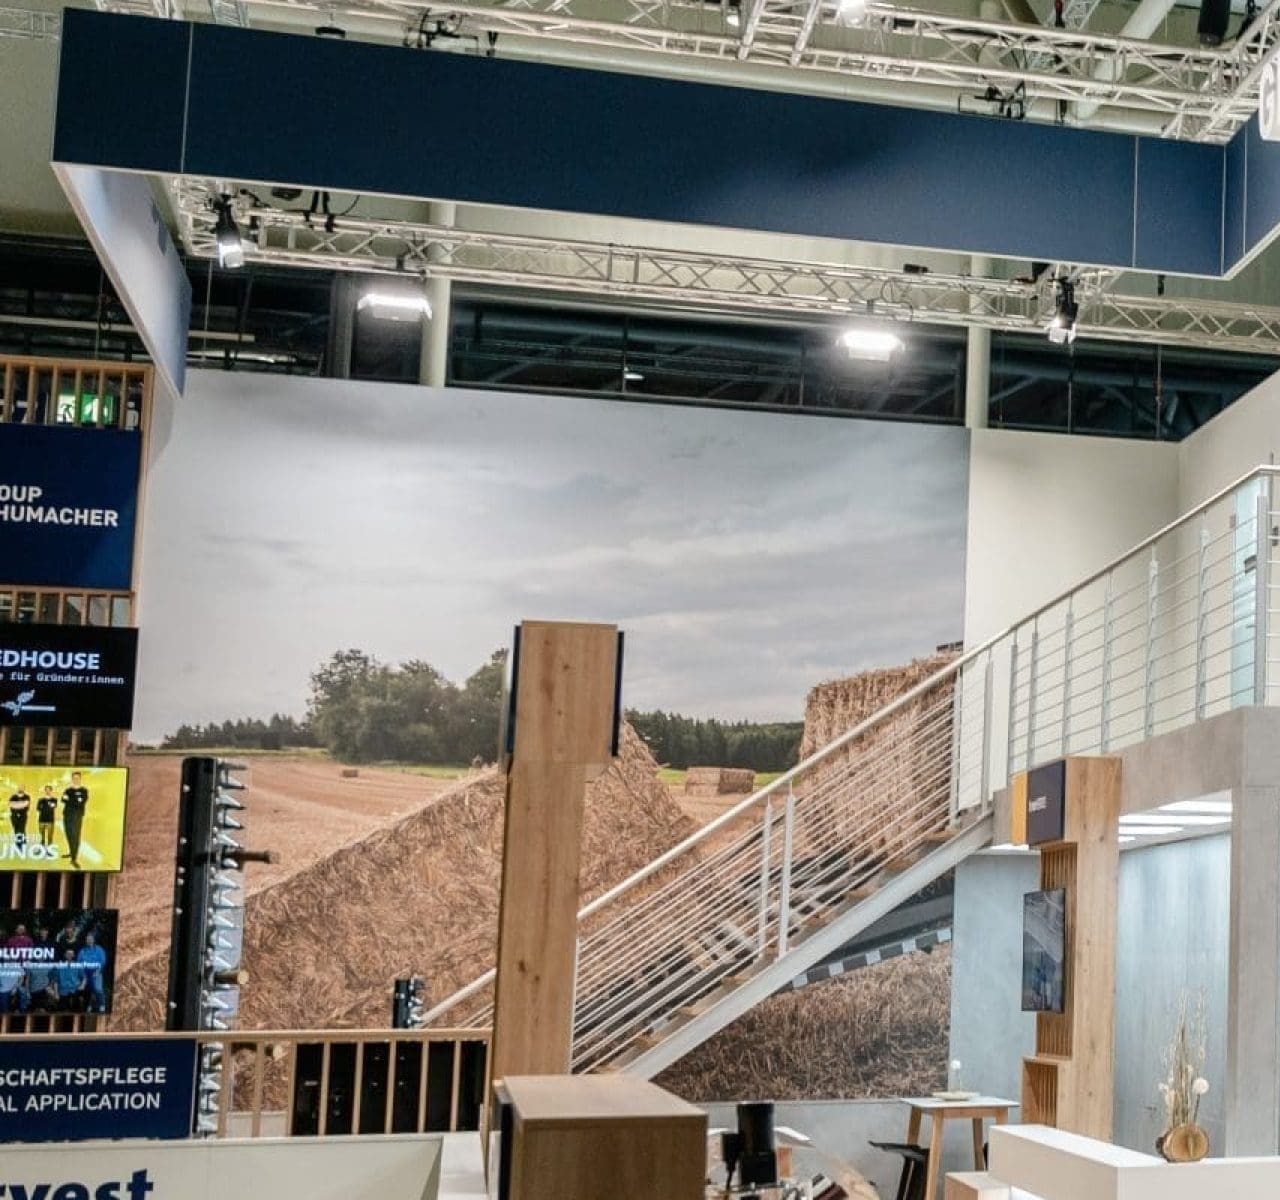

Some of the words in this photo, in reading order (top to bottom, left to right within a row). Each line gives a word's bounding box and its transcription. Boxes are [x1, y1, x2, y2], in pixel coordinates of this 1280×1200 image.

[0, 650, 100, 670] DHOUSE
[0, 947, 55, 960] LUTION
[25, 1092, 161, 1112] APPLICATION
